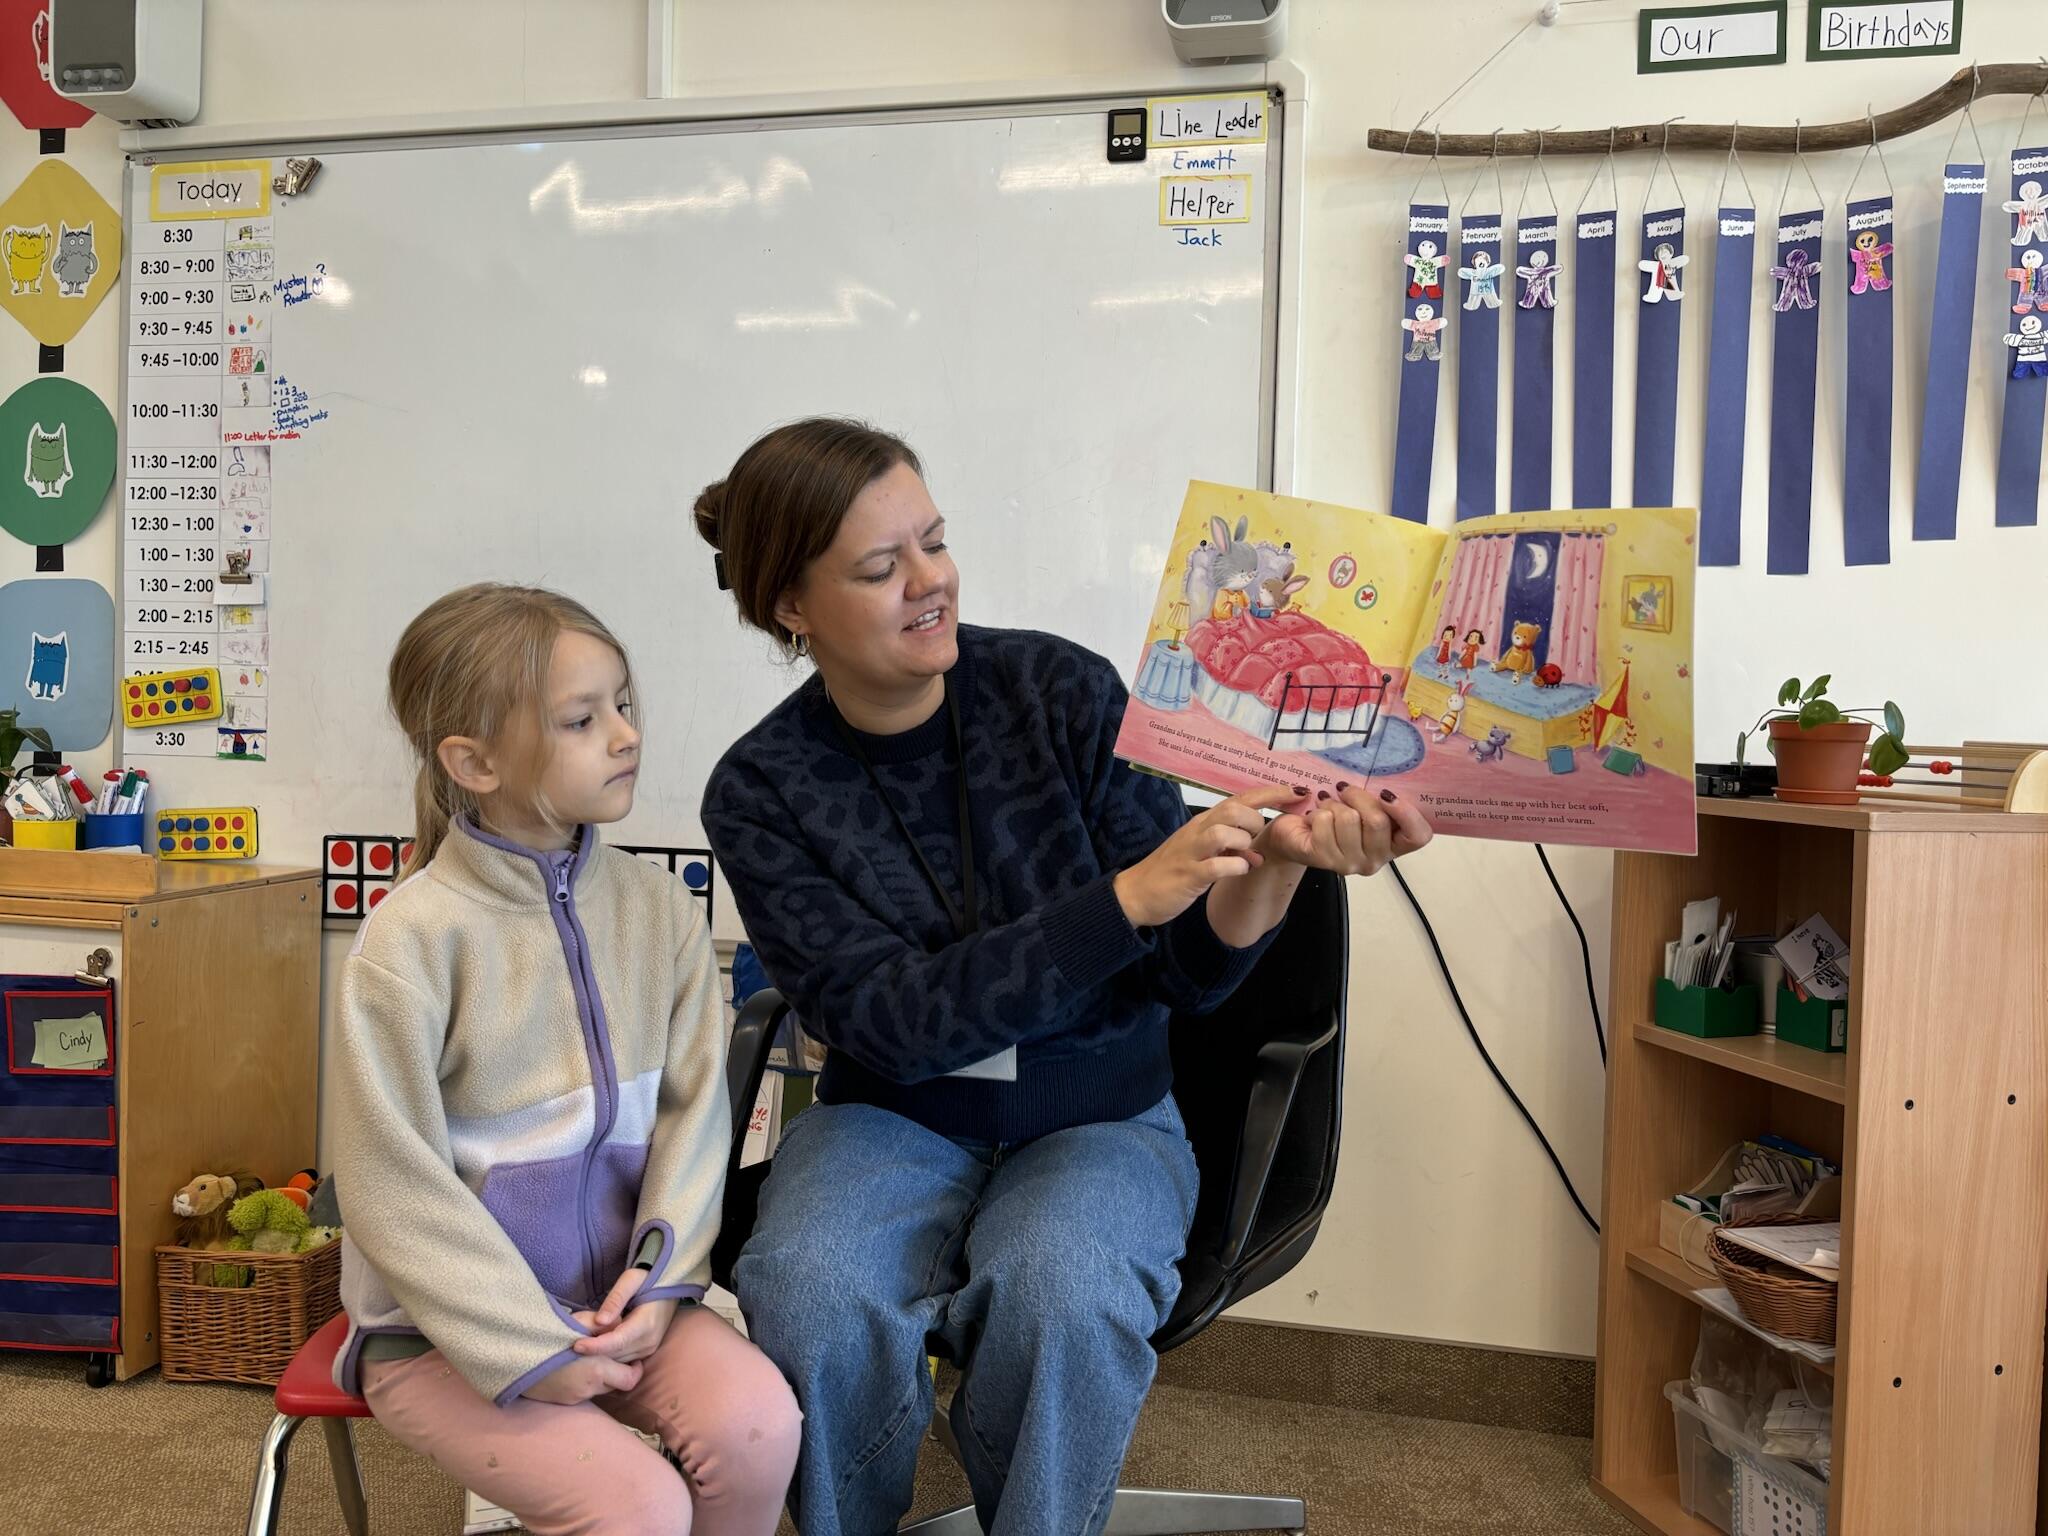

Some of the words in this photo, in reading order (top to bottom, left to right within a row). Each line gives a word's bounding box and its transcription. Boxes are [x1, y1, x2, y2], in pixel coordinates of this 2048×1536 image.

[1210, 14, 1232, 22] EPSON
[1826, 9, 1949, 49] Birthdays
[1659, 25, 1725, 56] Our
[1160, 109, 1203, 138] Line
[1215, 102, 1262, 138] Leader
[1173, 149, 1237, 170] Emmett
[2018, 161, 2048, 170] Octobe
[178, 180, 242, 202] Today
[1947, 182, 1985, 191] September
[1170, 186, 1235, 219] Helper
[1415, 221, 1443, 230] January
[1726, 224, 1744, 232] June
[1855, 215, 1884, 226] August
[163, 228, 193, 243] 8:30
[1466, 232, 1498, 241] February
[1525, 232, 1549, 240] March
[1587, 226, 1605, 235] April
[1656, 225, 1674, 233] May
[1792, 228, 1807, 237] July
[1172, 228, 1223, 247] Jack
[140, 260, 170, 275] 8:30
[185, 258, 215, 273] 9:00
[273, 273, 307, 296] Mystery
[140, 290, 169, 305] 9:00
[185, 289, 214, 304] 9:30
[139, 321, 168, 336] 9:30
[184, 320, 213, 335] 9:45
[141, 352, 169, 367] 9:45
[132, 403, 169, 418] 10:00
[224, 432, 243, 443] 11:00
[244, 431, 267, 442] Letter
[131, 454, 168, 469] 11:30
[130, 486, 167, 500] 12:00
[131, 516, 169, 531] 12:30
[186, 517, 214, 531] 1:00
[140, 547, 168, 562] 1:00
[185, 548, 214, 562] 1:30
[139, 578, 168, 592] 1:30
[183, 578, 214, 593] 2:00
[138, 608, 168, 623] 2:00
[183, 609, 213, 624] 2:15
[134, 639, 163, 654] 2:15
[179, 640, 209, 655] 2:45
[155, 731, 185, 746] 3:30
[1149, 721, 1175, 735] Grandma
[1176, 730, 1196, 742] always
[1197, 737, 1212, 747] reads
[1228, 747, 1244, 758] story
[1245, 751, 1264, 763] before
[1288, 764, 1303, 777] sleep
[1312, 774, 1332, 785] night.
[1158, 737, 1169, 748] She
[1170, 743, 1182, 752] uses
[1183, 745, 1194, 756] lots
[1203, 752, 1228, 767] different
[1229, 762, 1247, 773] voices
[1248, 767, 1261, 777] that
[1261, 773, 1279, 784] make
[1420, 794, 1434, 805] My
[1436, 796, 1474, 805] grandma
[1476, 798, 1498, 806] tucks
[1515, 801, 1527, 809] up
[1529, 800, 1549, 809] with
[1551, 801, 1566, 809] her
[1568, 801, 1586, 810] best
[1588, 803, 1609, 812] soft,
[1435, 810, 1454, 818] pink
[1456, 810, 1476, 820] quilt
[1489, 811, 1509, 822] keep
[1526, 815, 1546, 824] cosy
[1548, 815, 1565, 823] and
[59, 1029, 92, 1053] Cindy
